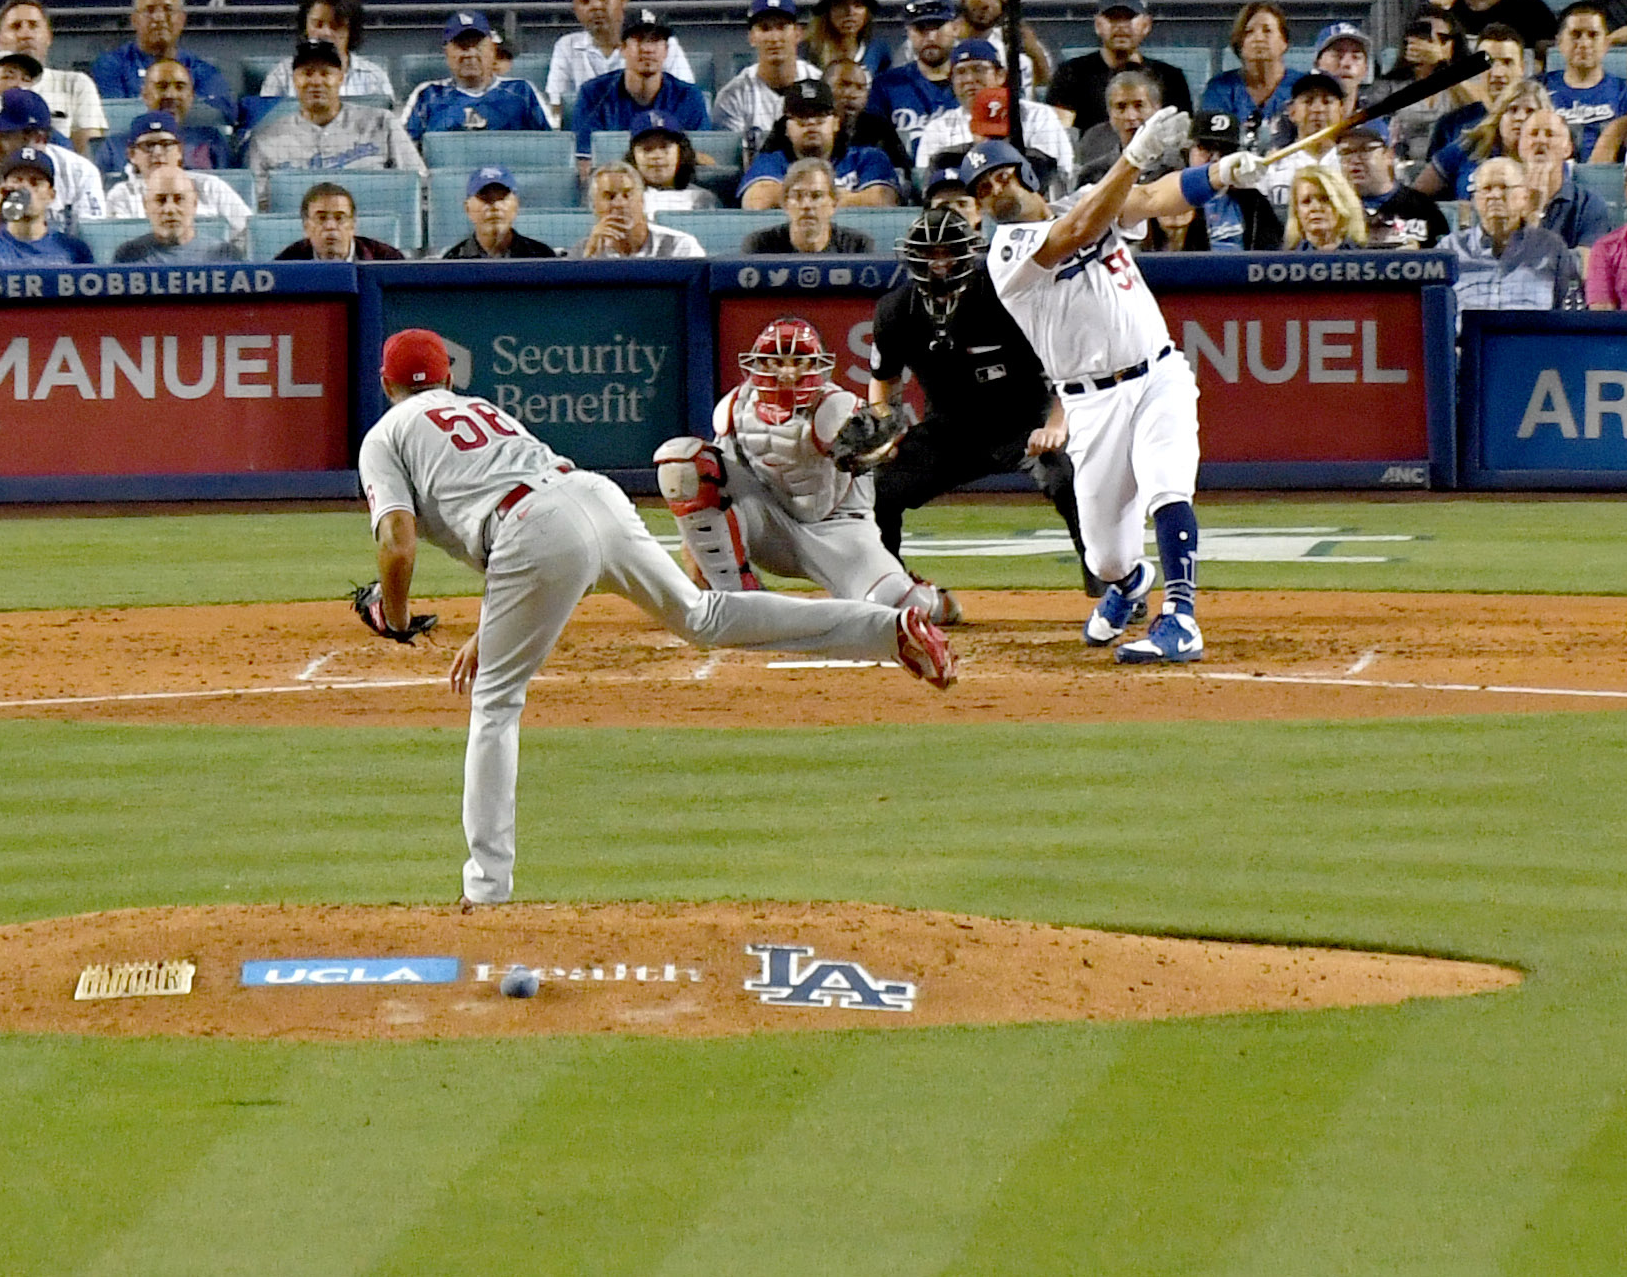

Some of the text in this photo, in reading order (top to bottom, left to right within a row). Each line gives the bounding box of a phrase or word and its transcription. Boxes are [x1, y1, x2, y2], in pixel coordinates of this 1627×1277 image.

[1210, 115, 1230, 131] D
[967, 151, 987, 168] LA
[1247, 261, 1446, 282] DODGERS.COM
[58, 270, 275, 298] BOBBLEHEAD
[492, 334, 669, 385] Security
[1185, 319, 1410, 385] NUEL
[1379, 465, 1425, 486] ANC
[263, 967, 424, 984] UCLA
[745, 942, 916, 1012] LA
